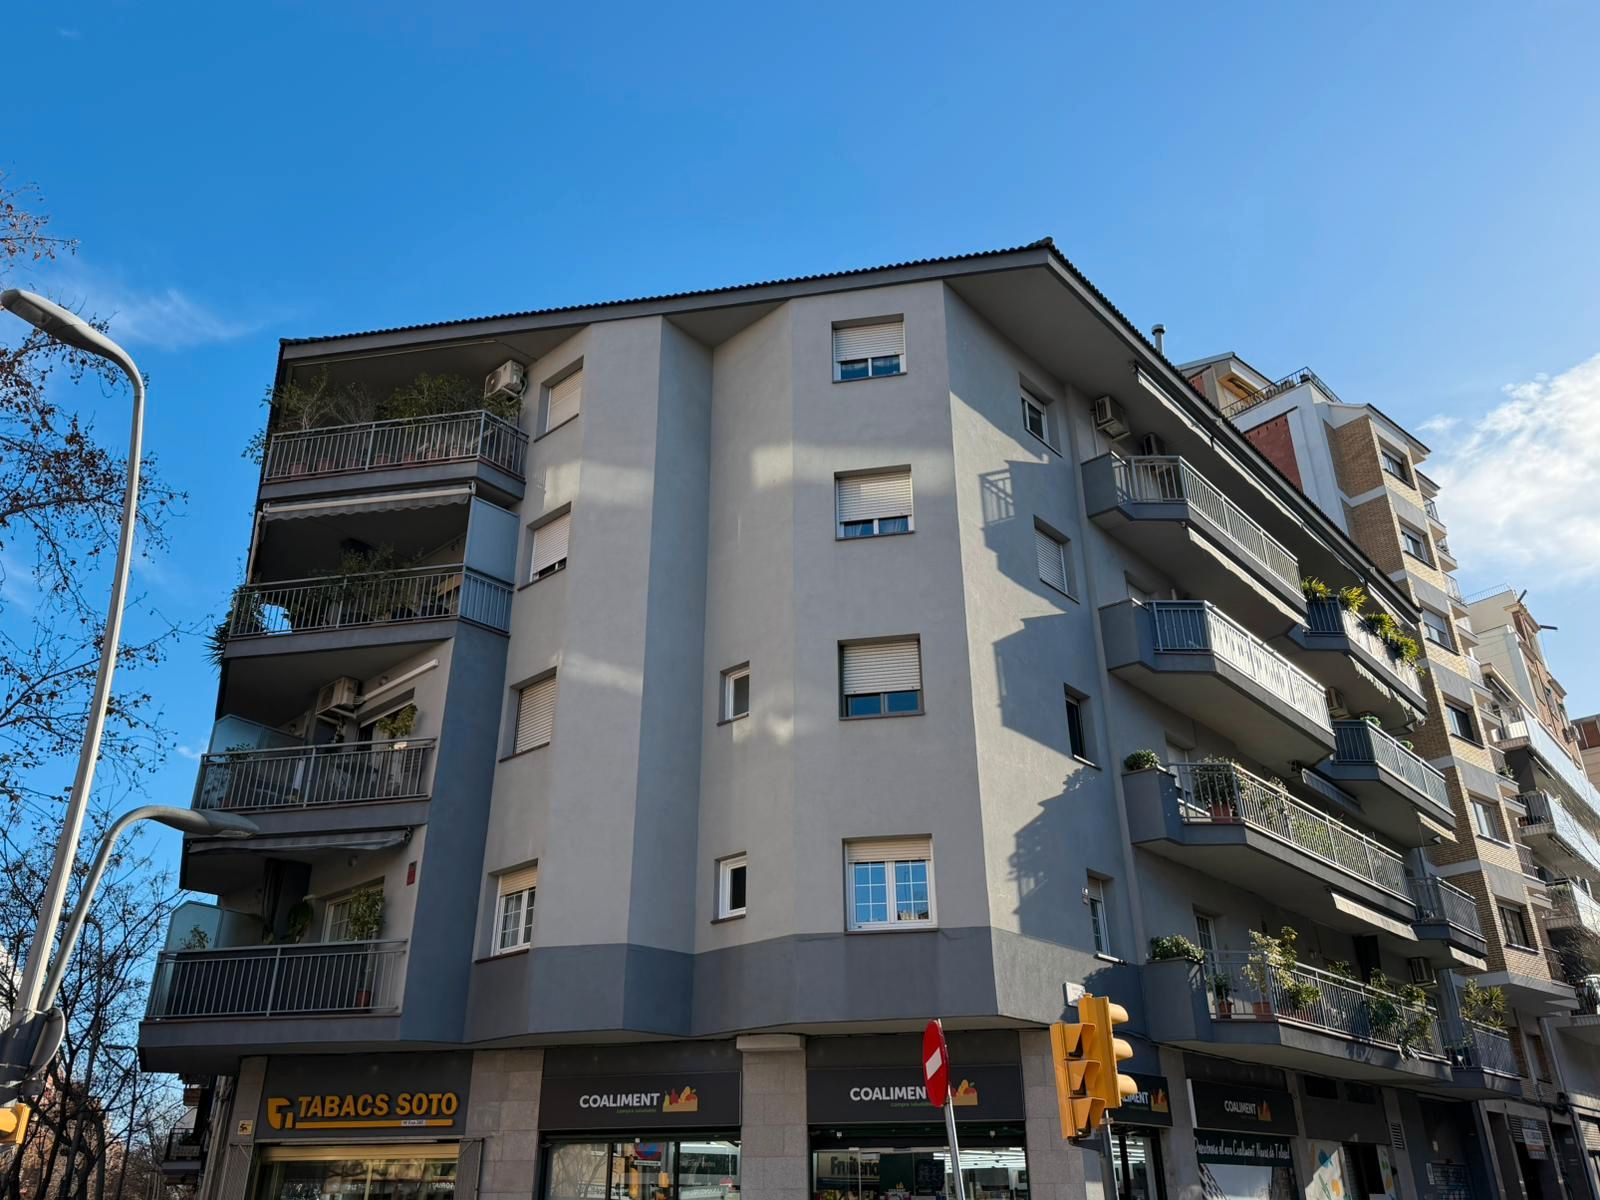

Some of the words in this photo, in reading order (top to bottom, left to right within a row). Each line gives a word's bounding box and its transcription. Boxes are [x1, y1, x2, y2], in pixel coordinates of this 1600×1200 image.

[579, 1092, 661, 1108] COALIMENT
[849, 1085, 927, 1101] COALIMEN
[297, 1093, 390, 1118] TABACS
[395, 1092, 459, 1117] SOTO
[1223, 1099, 1257, 1115] COALIMENT
